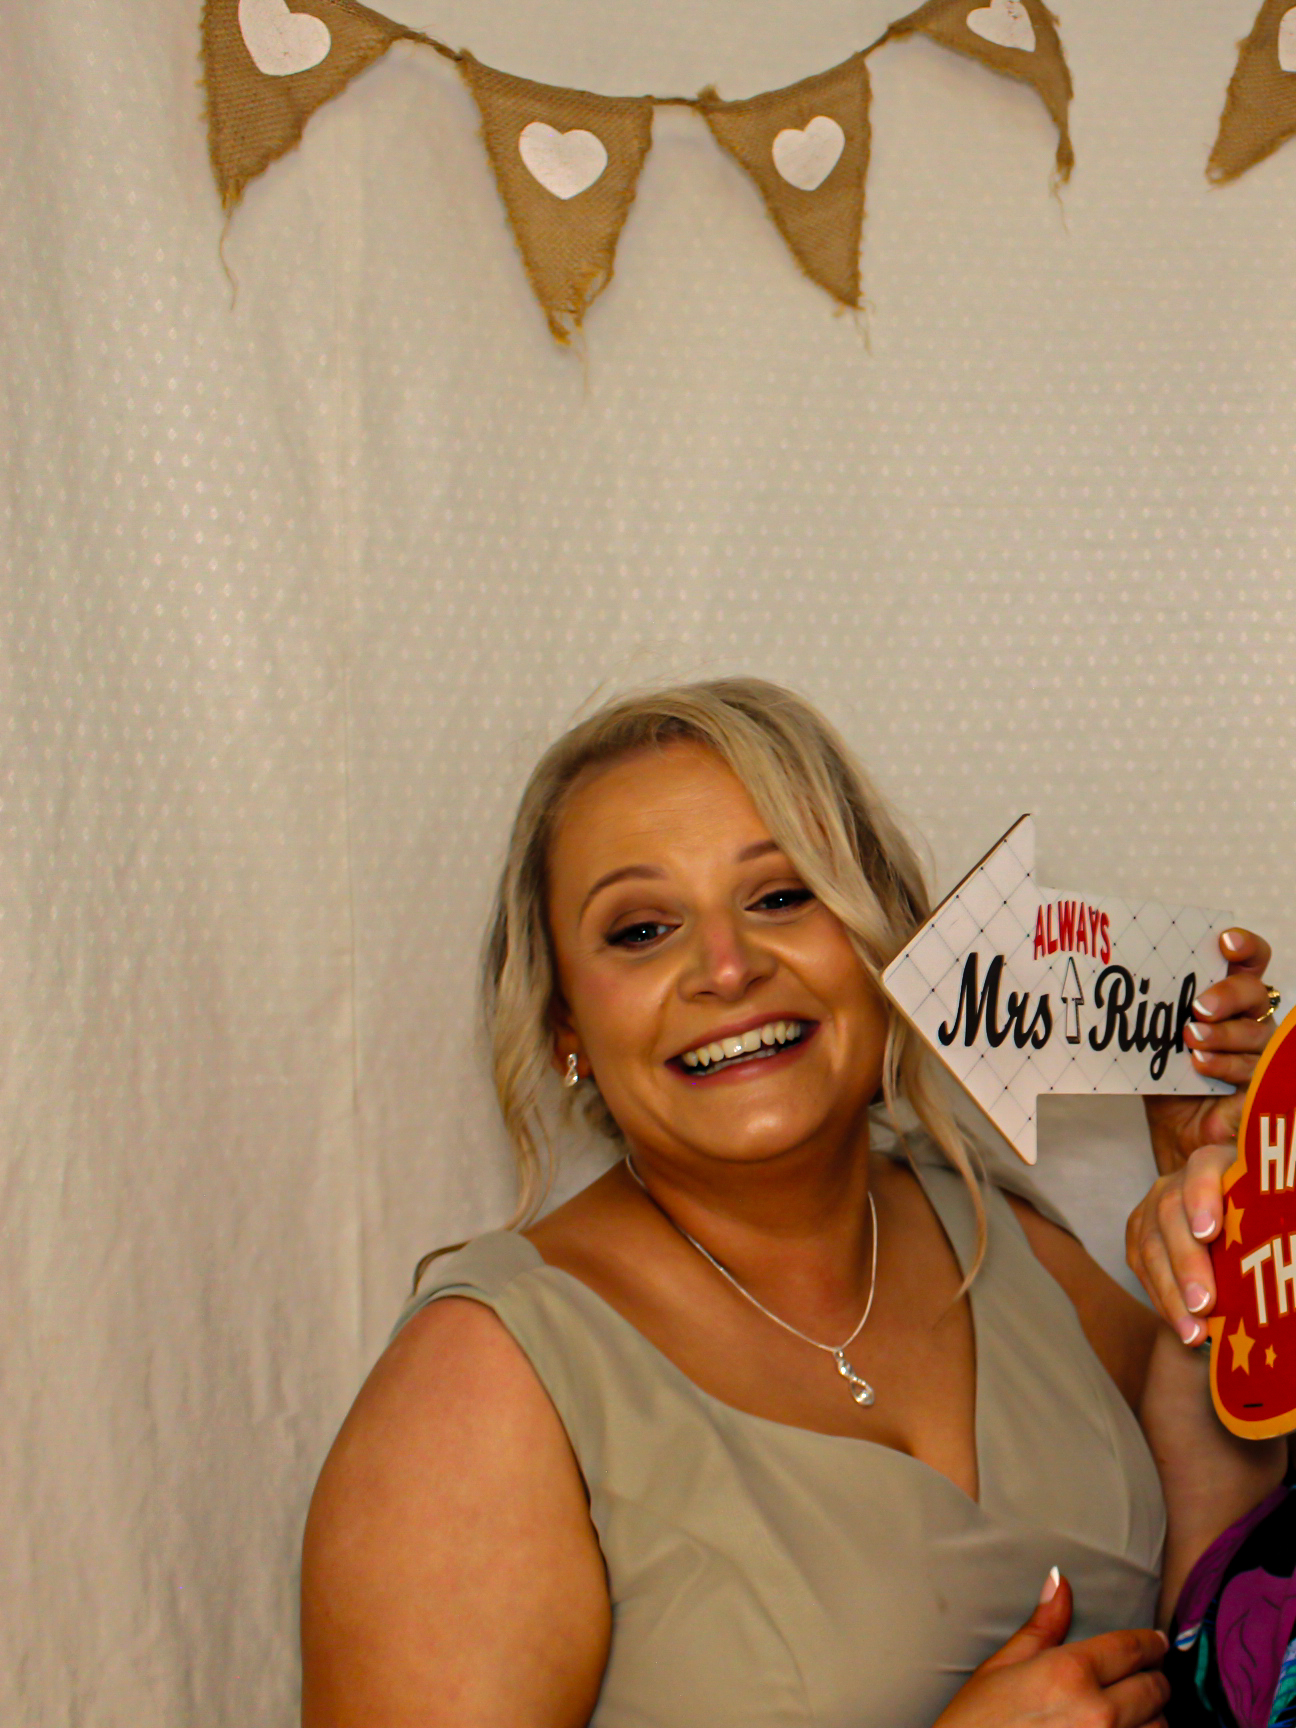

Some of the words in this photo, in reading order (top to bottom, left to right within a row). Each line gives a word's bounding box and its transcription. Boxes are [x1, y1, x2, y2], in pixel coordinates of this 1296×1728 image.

[1033, 900, 1111, 965] ALWAYS
[938, 952, 1053, 1050] Mrs
[1088, 965, 1197, 1081] Righ
